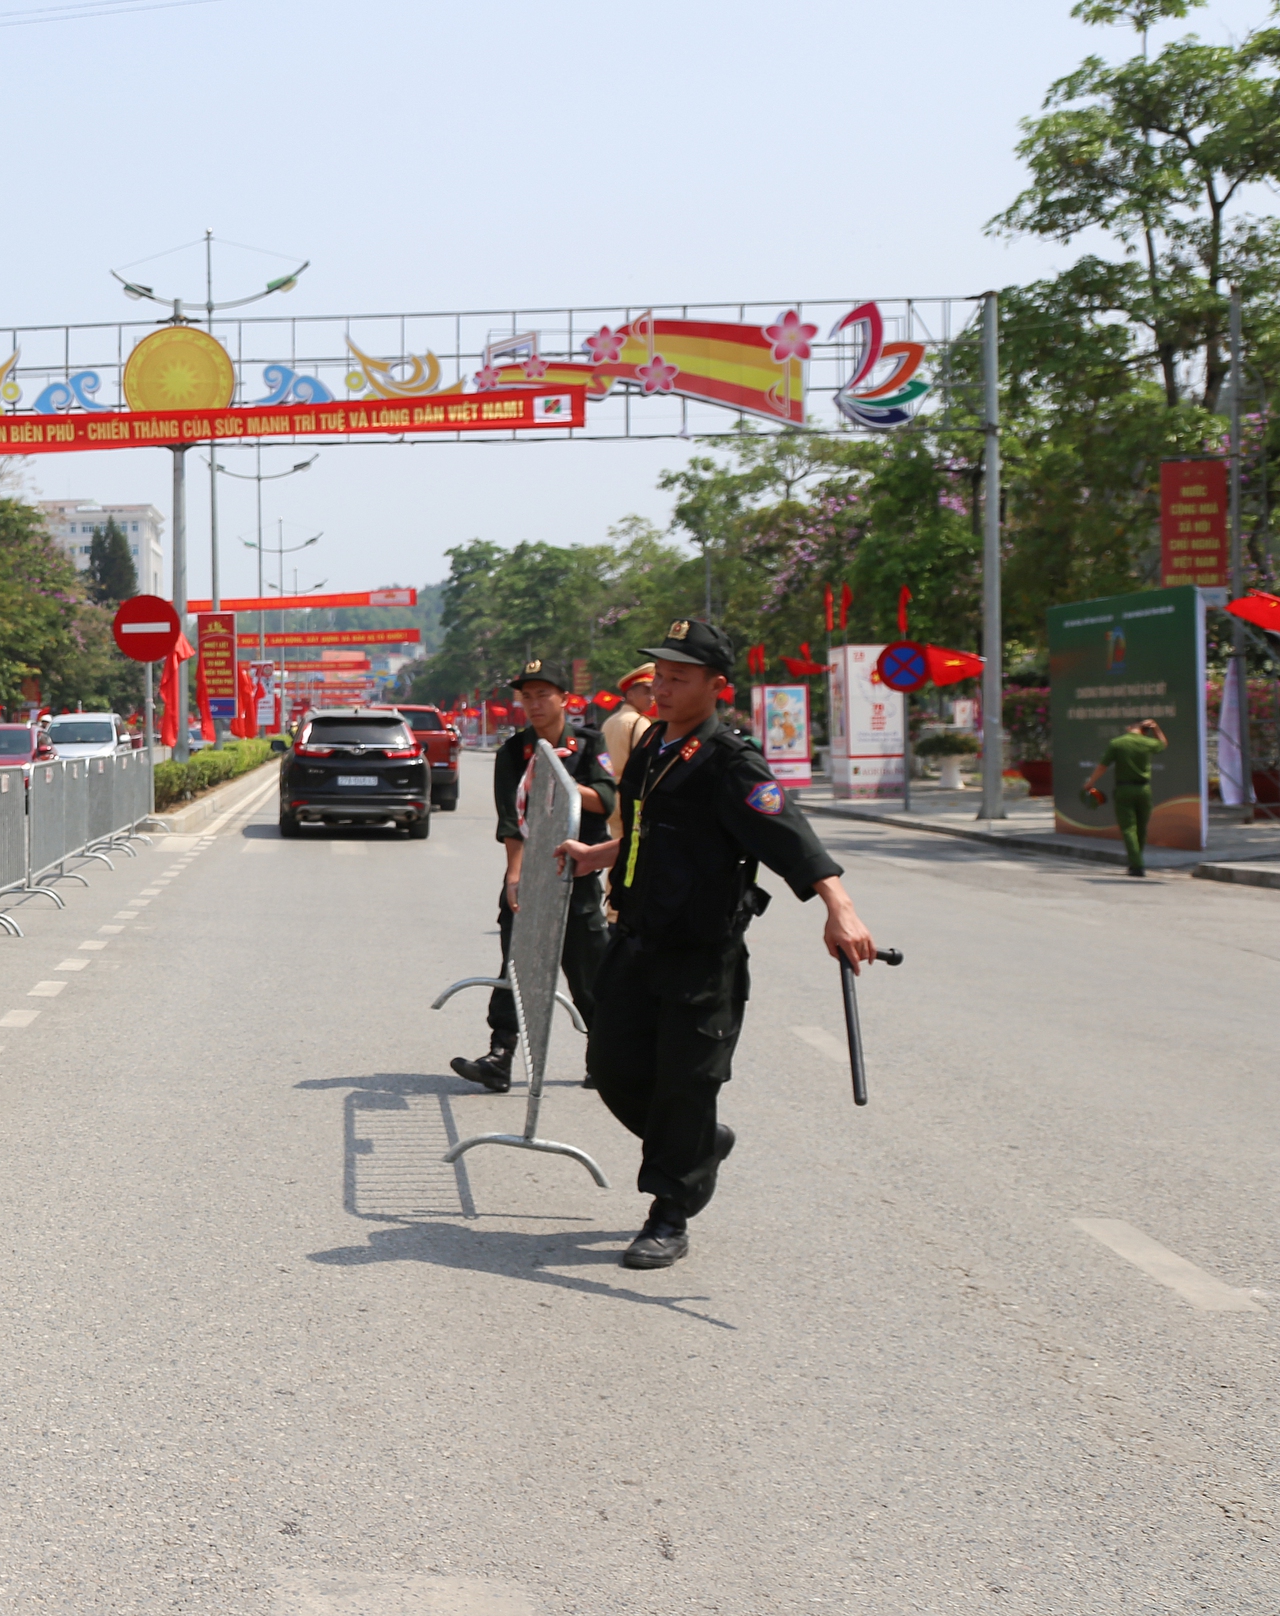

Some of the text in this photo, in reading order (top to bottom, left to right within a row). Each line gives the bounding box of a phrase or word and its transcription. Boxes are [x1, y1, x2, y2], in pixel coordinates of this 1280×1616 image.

[10, 420, 43, 443] BIÊN
[46, 418, 75, 442] PHỦ
[87, 418, 130, 441] CHIẾN
[133, 417, 179, 439] THẮNG
[182, 414, 211, 438] CỦA
[214, 415, 244, 436] SỨC
[247, 414, 290, 436] MẠNH
[293, 411, 316, 431] TRÍ
[319, 409, 345, 432] TUỆ
[349, 407, 369, 428] VÀ
[371, 406, 410, 427] LÒNG
[413, 403, 444, 425] DÂN
[448, 401, 479, 424] VIỆT
[481, 400, 524, 420] NAM!
